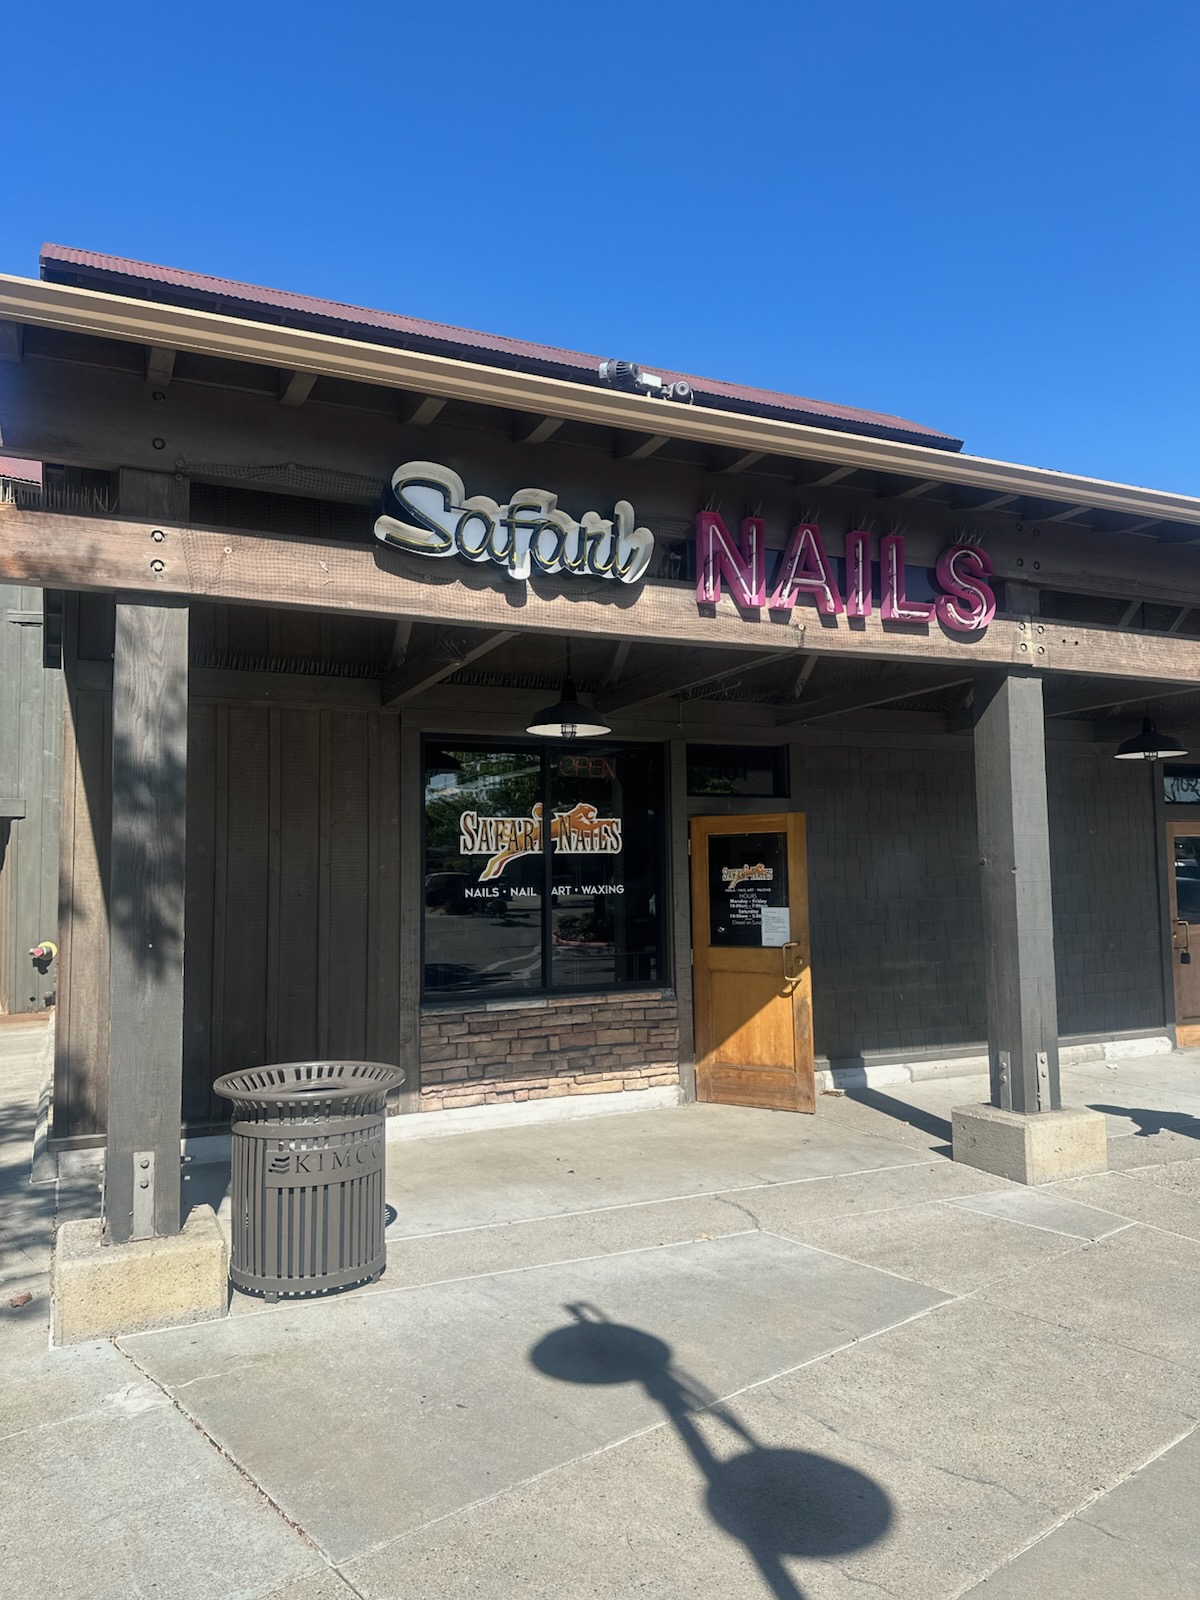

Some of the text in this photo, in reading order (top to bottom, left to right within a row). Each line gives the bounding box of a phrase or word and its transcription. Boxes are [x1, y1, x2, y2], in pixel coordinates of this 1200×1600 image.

[373, 460, 998, 633] Safari NAILS
[560, 755, 616, 779] OPEN
[465, 884, 625, 898] NAILS NAIL ART WAXING
[295, 1140, 381, 1173] KIMCO
